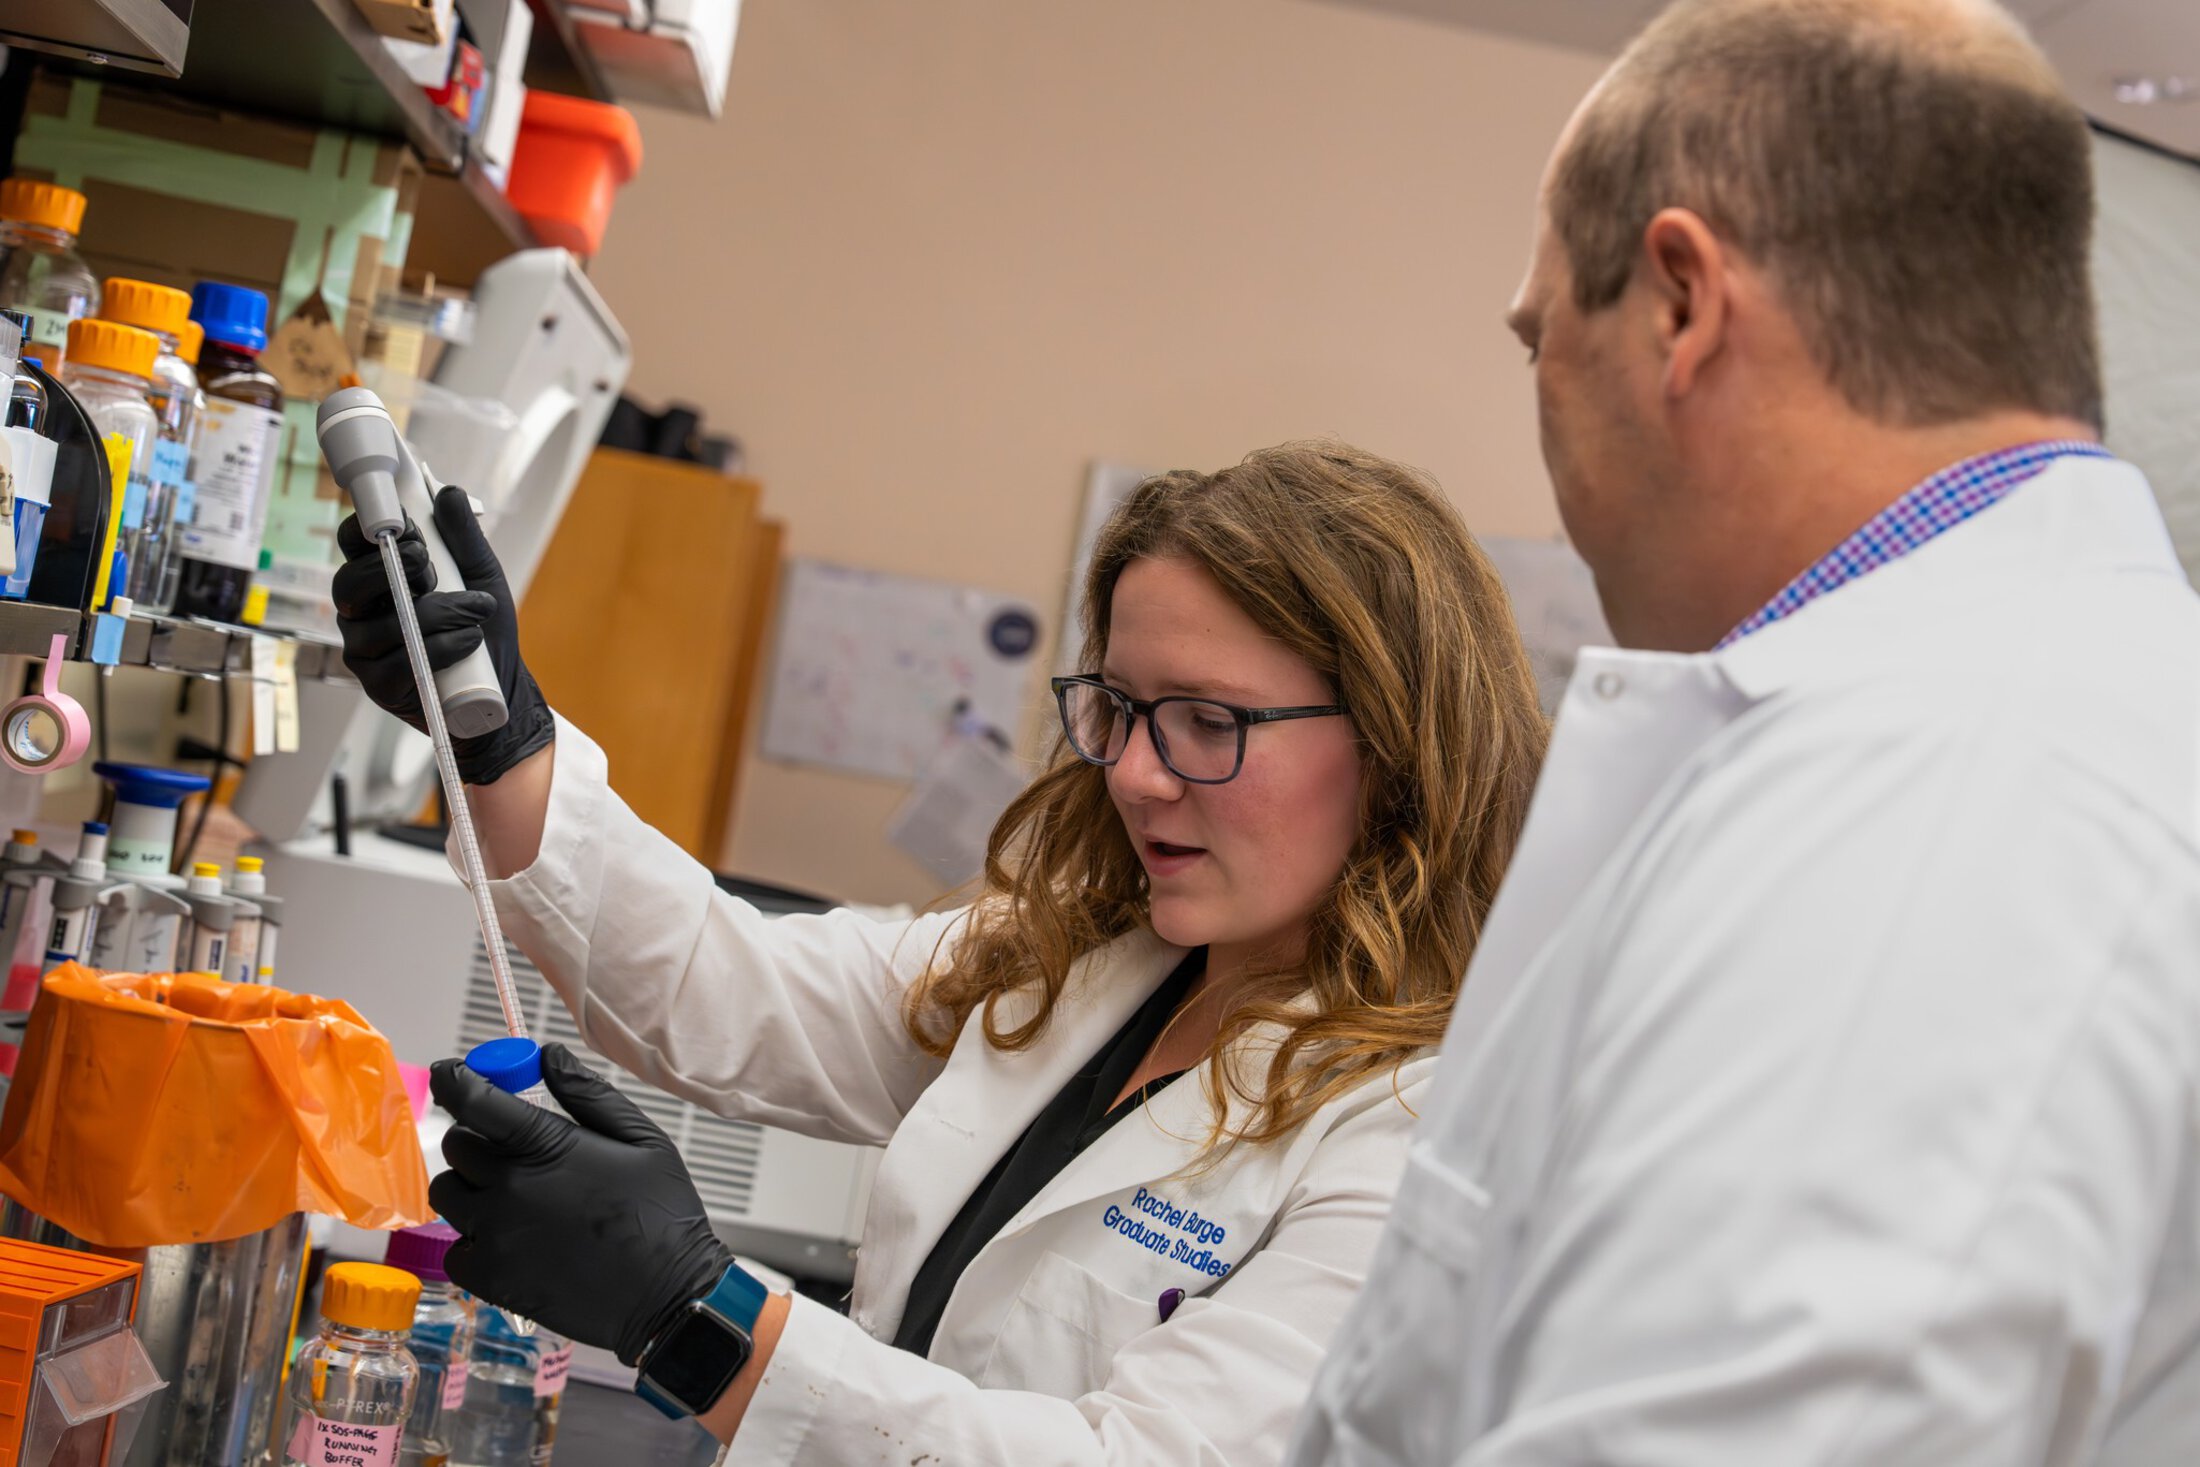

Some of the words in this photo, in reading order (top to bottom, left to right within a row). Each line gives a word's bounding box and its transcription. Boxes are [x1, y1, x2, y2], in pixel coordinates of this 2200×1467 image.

[1103, 1204, 1171, 1256] Graduate
[1169, 1238, 1232, 1278] Studies
[1131, 1186, 1188, 1229] Rachel
[1182, 1211, 1226, 1245] Burge
